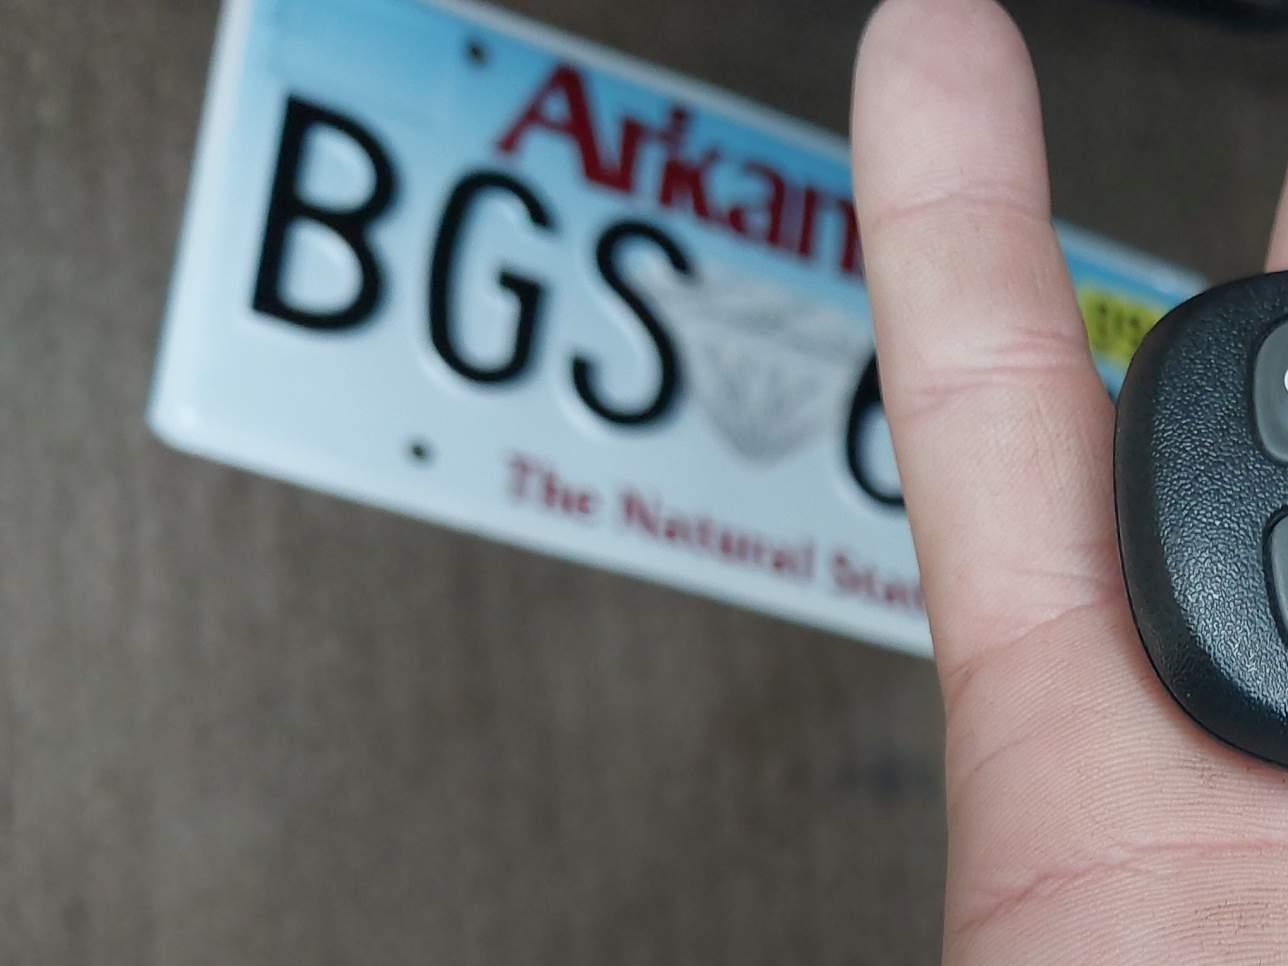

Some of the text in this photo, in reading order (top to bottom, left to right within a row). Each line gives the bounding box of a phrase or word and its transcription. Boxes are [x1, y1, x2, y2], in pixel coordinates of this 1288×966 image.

[252, 95, 694, 429] BGS
[496, 63, 863, 275] Arkan
[506, 453, 926, 618] The Natural Stat
